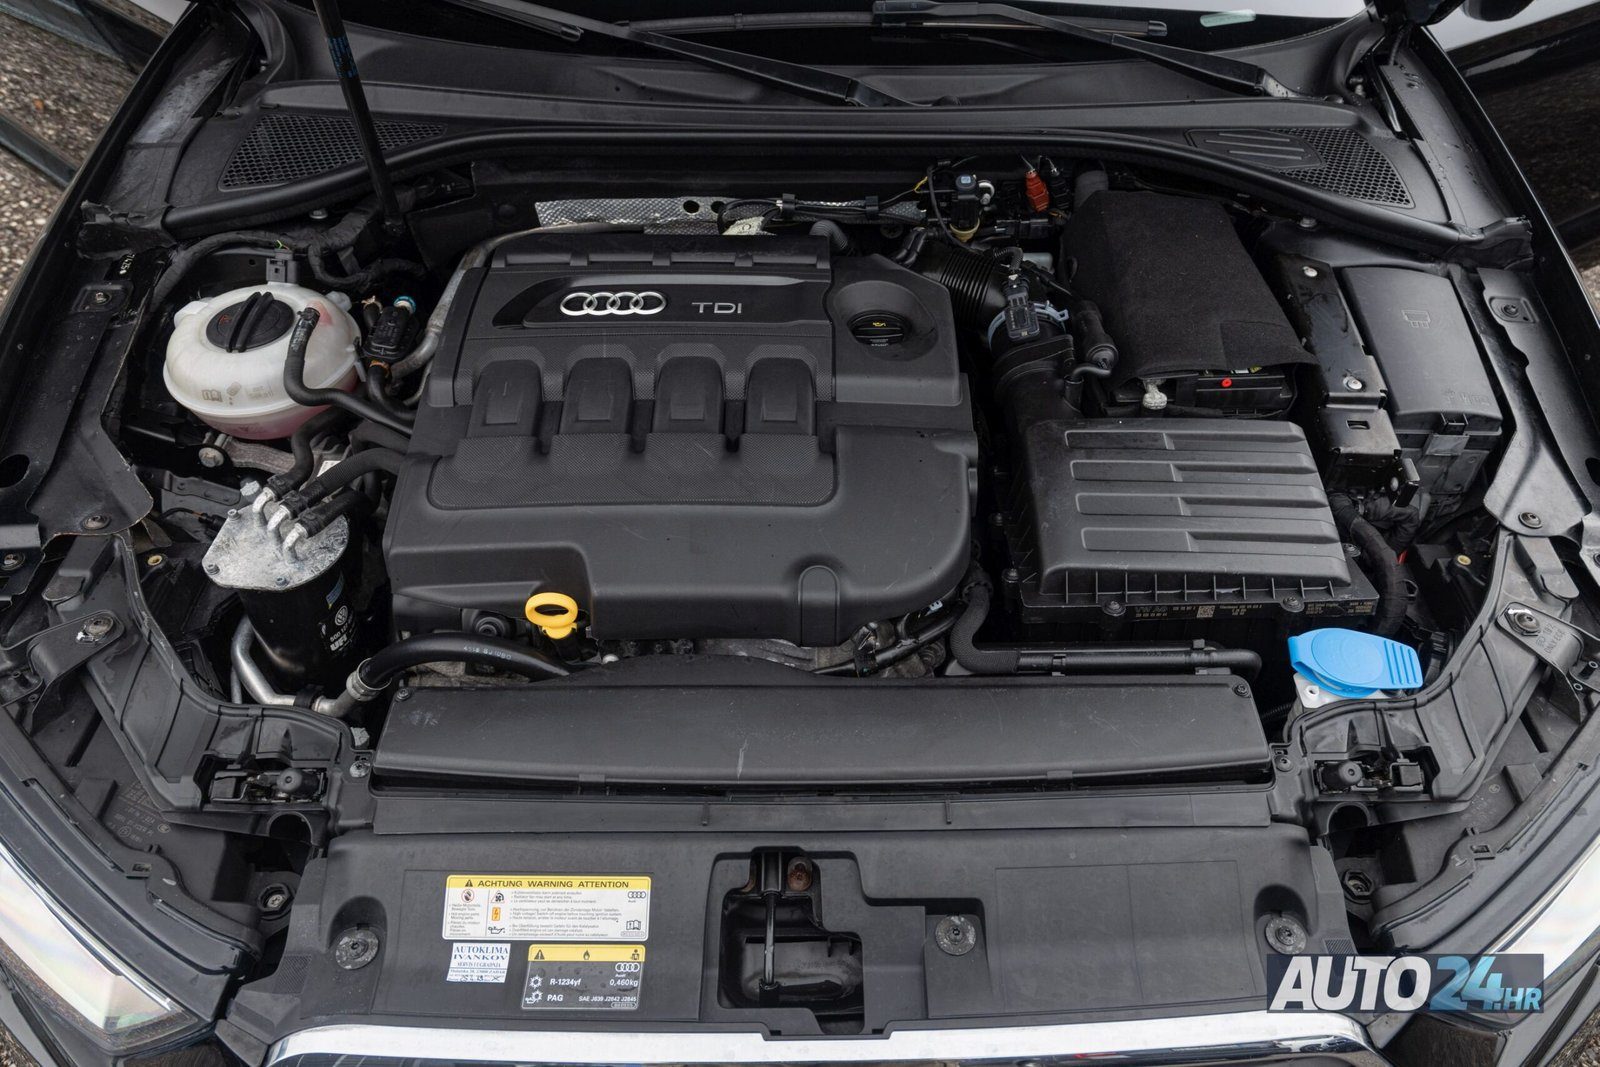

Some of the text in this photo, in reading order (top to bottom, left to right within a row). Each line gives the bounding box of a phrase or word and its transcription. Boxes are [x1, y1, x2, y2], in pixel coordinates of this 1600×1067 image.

[691, 302, 742, 314] TDI
[477, 880, 629, 888] ACHTUNG WARNING ATTENTION
[454, 946, 509, 954] AUTOKLIMA
[549, 978, 639, 987] R-1234yf 0,460kg
[546, 994, 564, 1002] PAG
